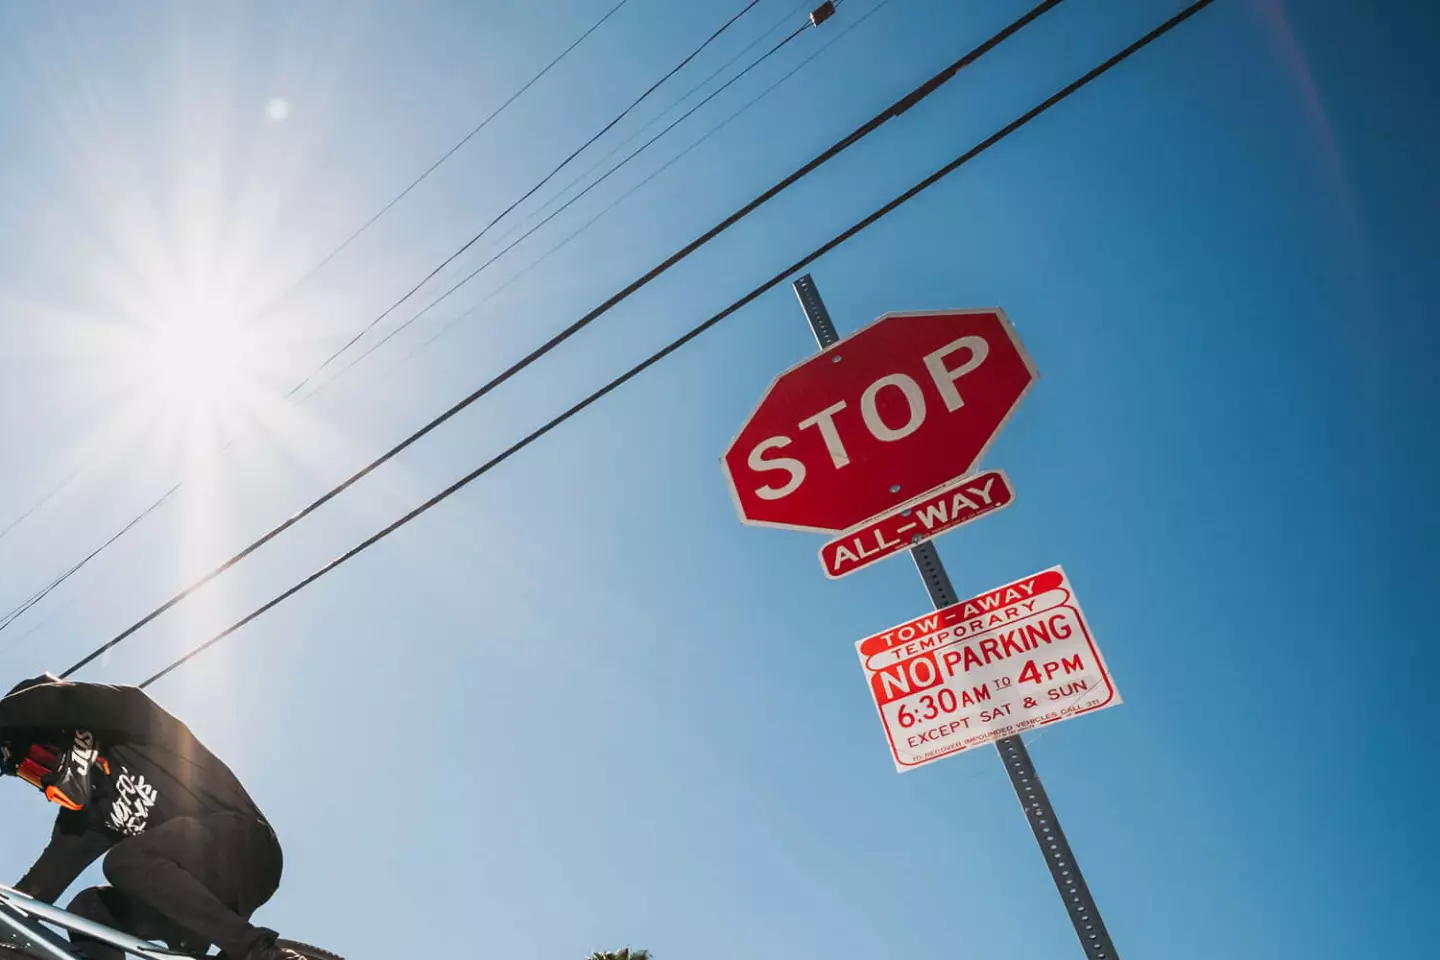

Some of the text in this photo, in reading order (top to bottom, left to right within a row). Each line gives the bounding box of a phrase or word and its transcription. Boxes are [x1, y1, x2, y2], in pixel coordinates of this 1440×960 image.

[748, 335, 989, 500] STOP
[834, 478, 994, 570] ALL-WAY
[881, 614, 1072, 700] NO PARKING
[892, 600, 1035, 659] TEMPORARY
[907, 717, 970, 748] EXCEPT
[980, 703, 1011, 722] SAT
[1023, 696, 1037, 710] &
[1047, 679, 1088, 701] SUN
[994, 676, 1012, 690] TO
[924, 742, 962, 758] RECOVER
[964, 725, 1013, 745] IMPOUNDED
[1015, 711, 1058, 728] VEHICLES
[1060, 704, 1081, 715] CALL
